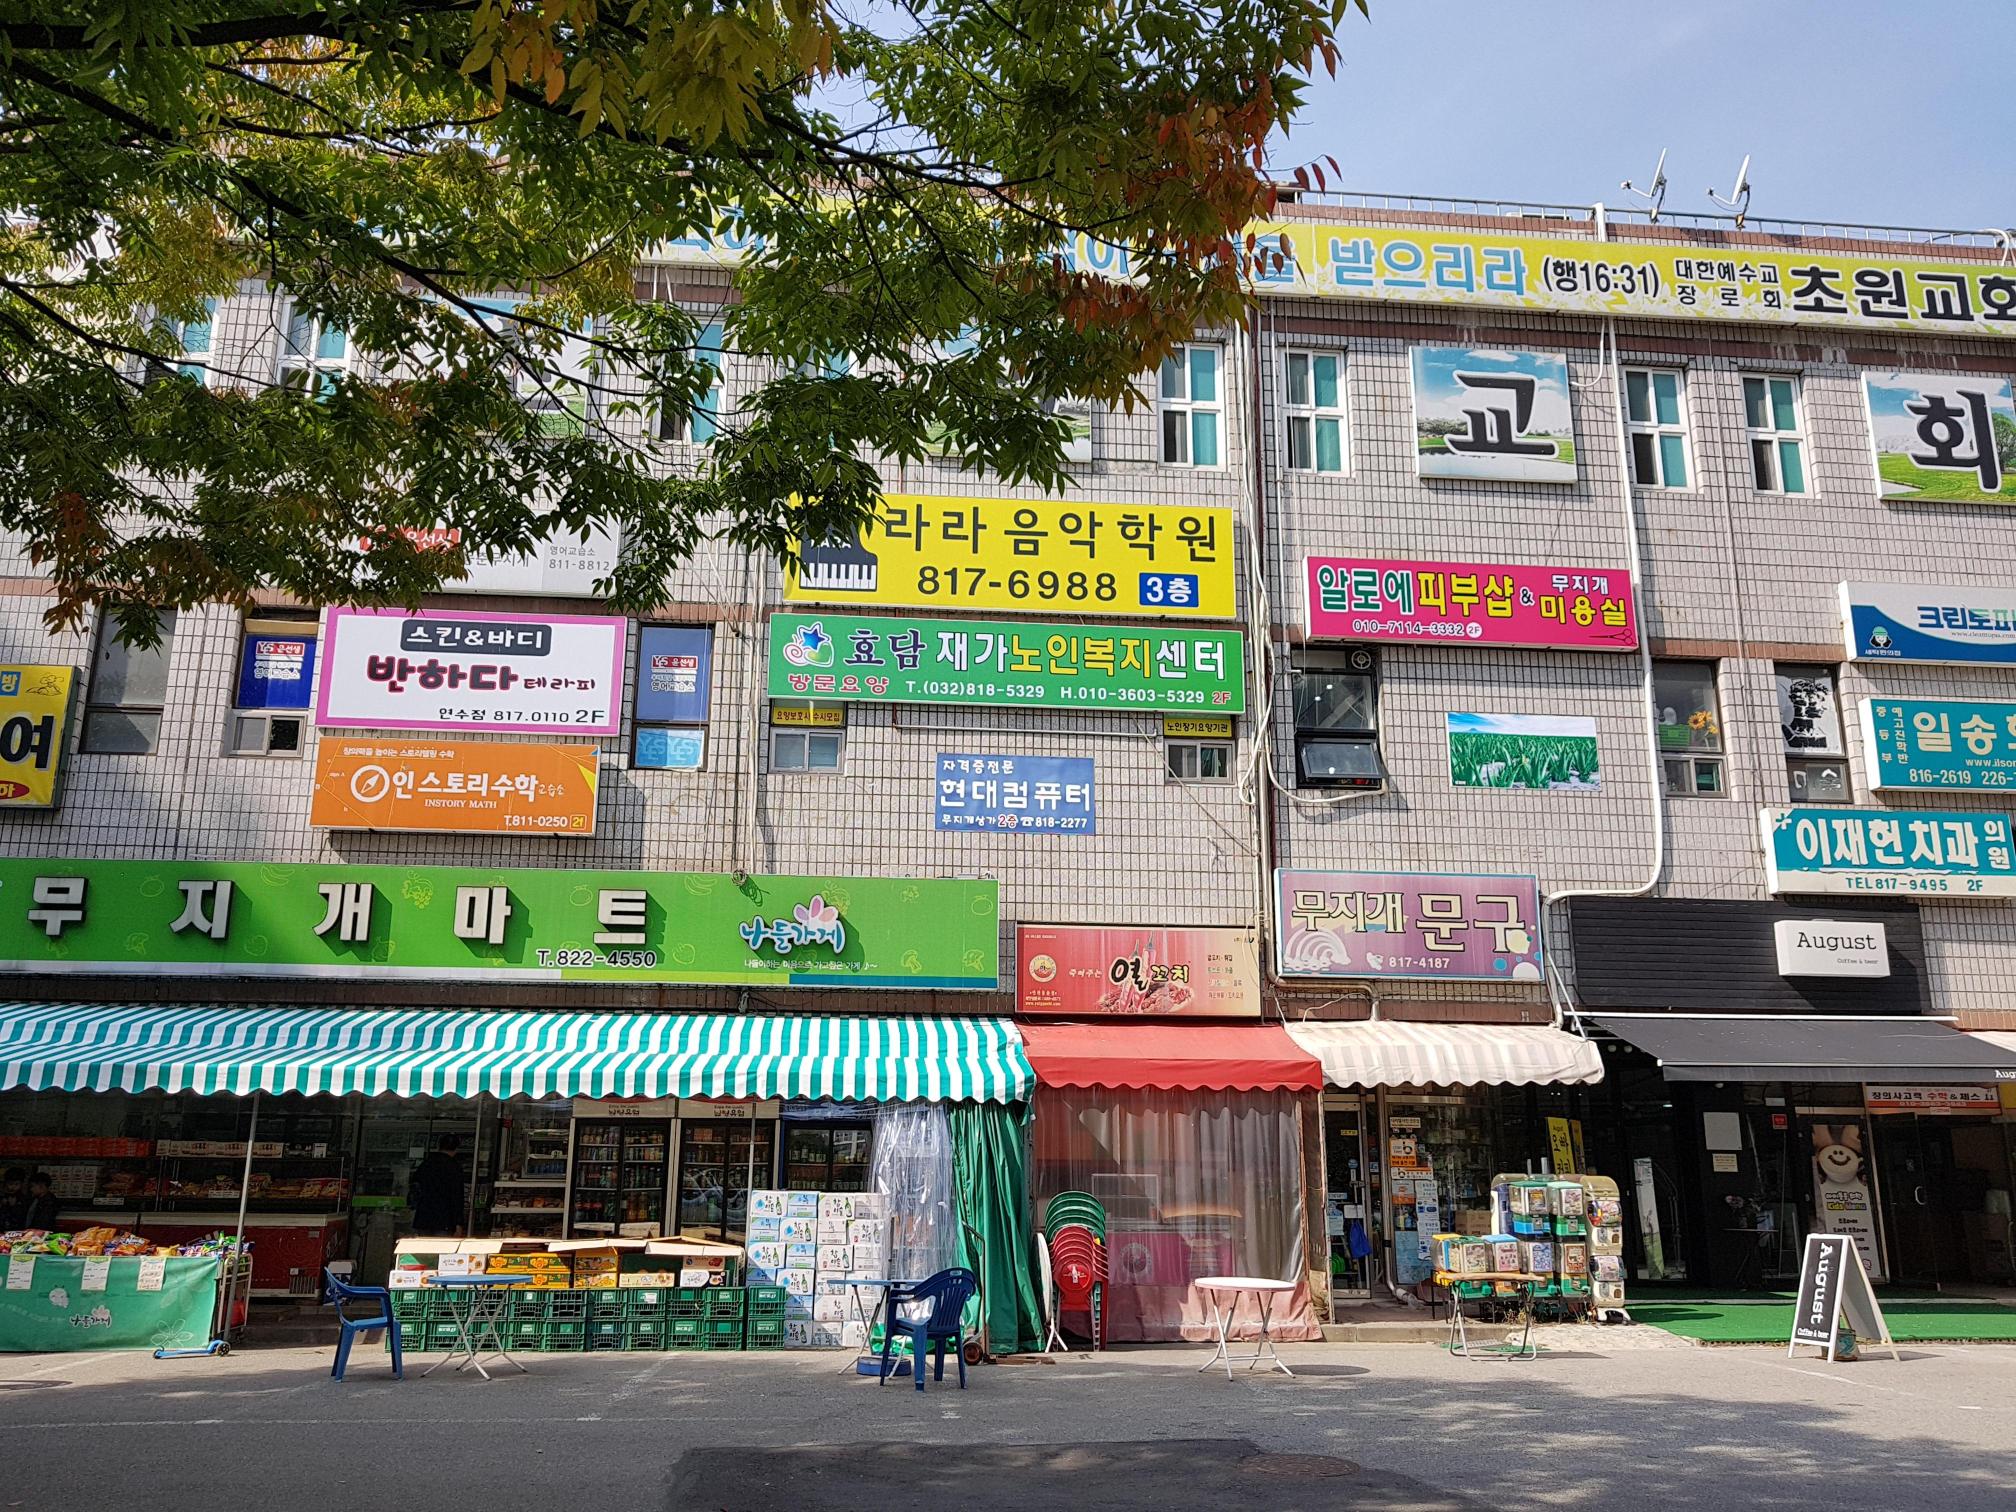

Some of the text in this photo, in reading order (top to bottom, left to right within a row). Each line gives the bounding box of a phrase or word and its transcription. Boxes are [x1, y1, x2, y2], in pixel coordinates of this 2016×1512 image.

[1331, 238, 1526, 296] 받으리라
[1543, 256, 1660, 299] (행16:31)
[1675, 259, 1780, 284] 대한예수교
[1448, 374, 1555, 456] 교
[1906, 390, 1999, 489] 회
[549, 559, 610, 571] 811-8812
[917, 565, 1193, 603] 817-6988 3층
[1521, 589, 1534, 605] &
[1551, 574, 1609, 595] 무지개
[1539, 595, 1628, 627] 미용실
[406, 625, 543, 649] 스킨&바디
[1353, 620, 1464, 635] 010-7114-3332
[843, 628, 928, 672] 효담
[367, 655, 596, 693] 반하다 테라피
[789, 673, 890, 694] 방문요양
[1212, 691, 1231, 704] 2F
[438, 708, 605, 724] 연수점 817.0110 2F
[1167, 723, 1228, 733] 노인장기요양기관
[943, 760, 1015, 775] 자격증전문
[1909, 768, 1972, 784] 816-2619
[425, 799, 497, 809] INSTORY MATH
[939, 779, 1090, 812] 현대컴퓨터
[1035, 817, 1088, 829] 818-2277
[1967, 879, 1983, 892] 2F
[1292, 890, 1526, 953] 무지개 문구
[1797, 931, 1877, 952] August
[537, 950, 656, 968] T.822-4550
[1389, 957, 1451, 969] 817-4187
[1811, 1242, 1833, 1325] August
